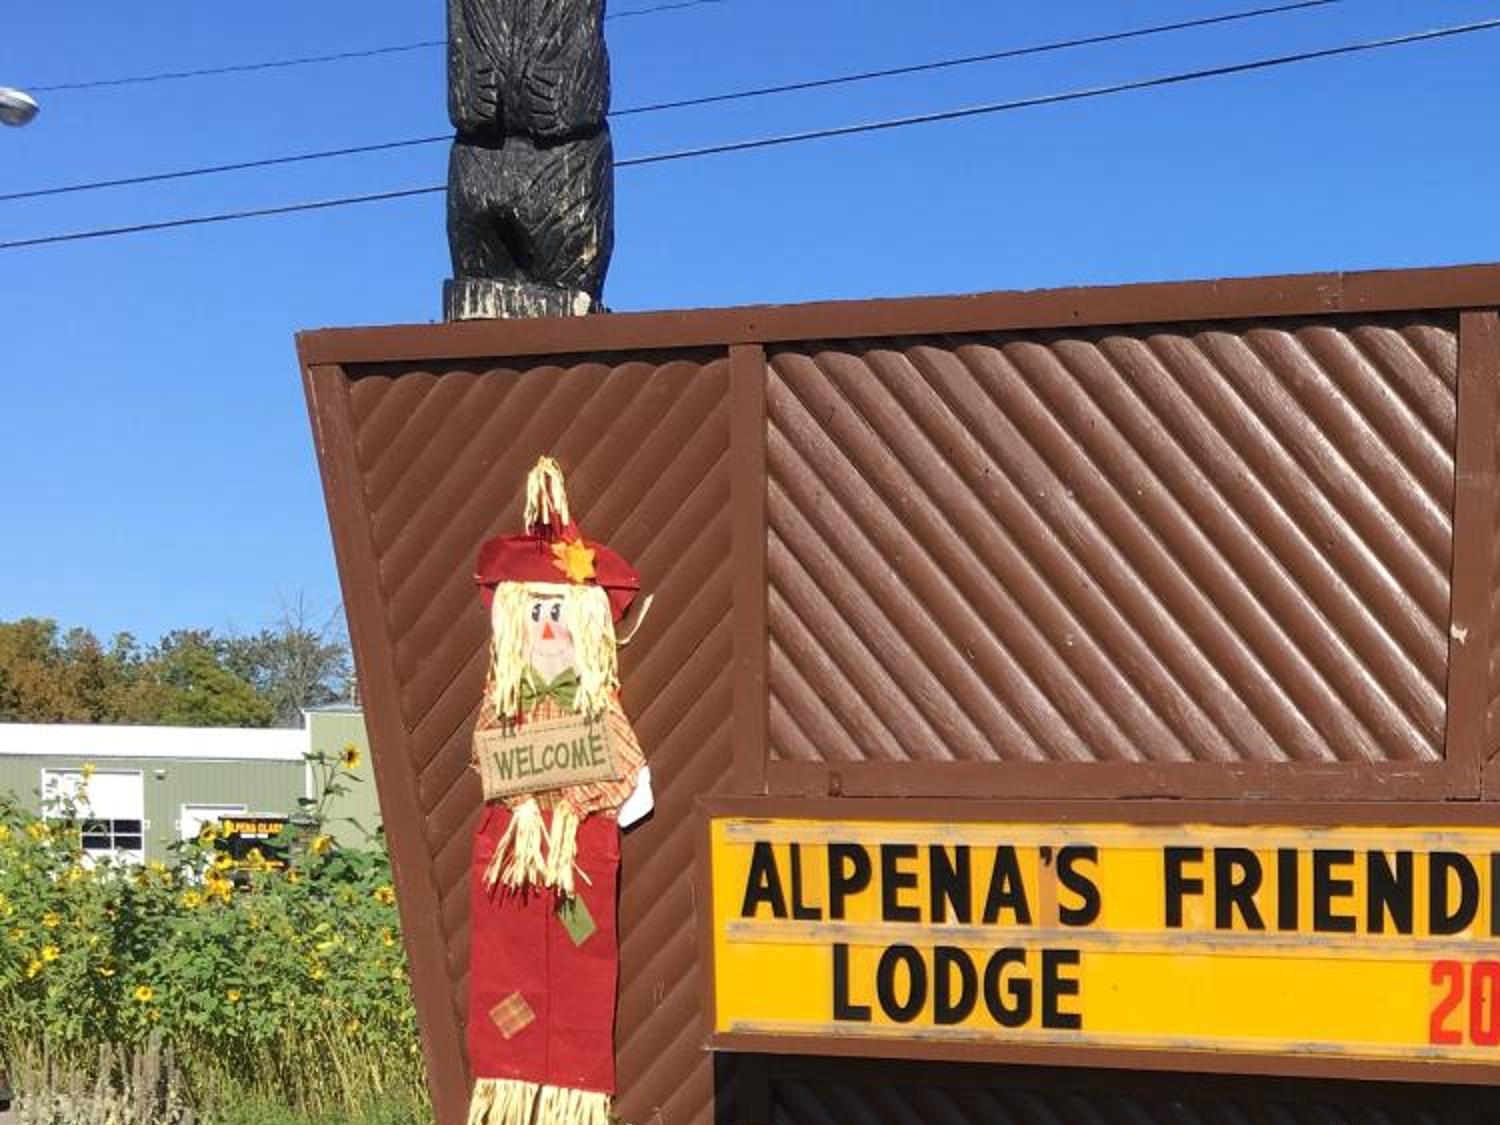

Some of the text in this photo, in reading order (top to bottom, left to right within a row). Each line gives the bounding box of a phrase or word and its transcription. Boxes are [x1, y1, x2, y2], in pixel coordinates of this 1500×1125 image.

[493, 735, 606, 781] WELCOME
[227, 822, 256, 833] LPENA
[741, 841, 1100, 926] ALPENA'S
[833, 943, 1082, 1030] LODGE
